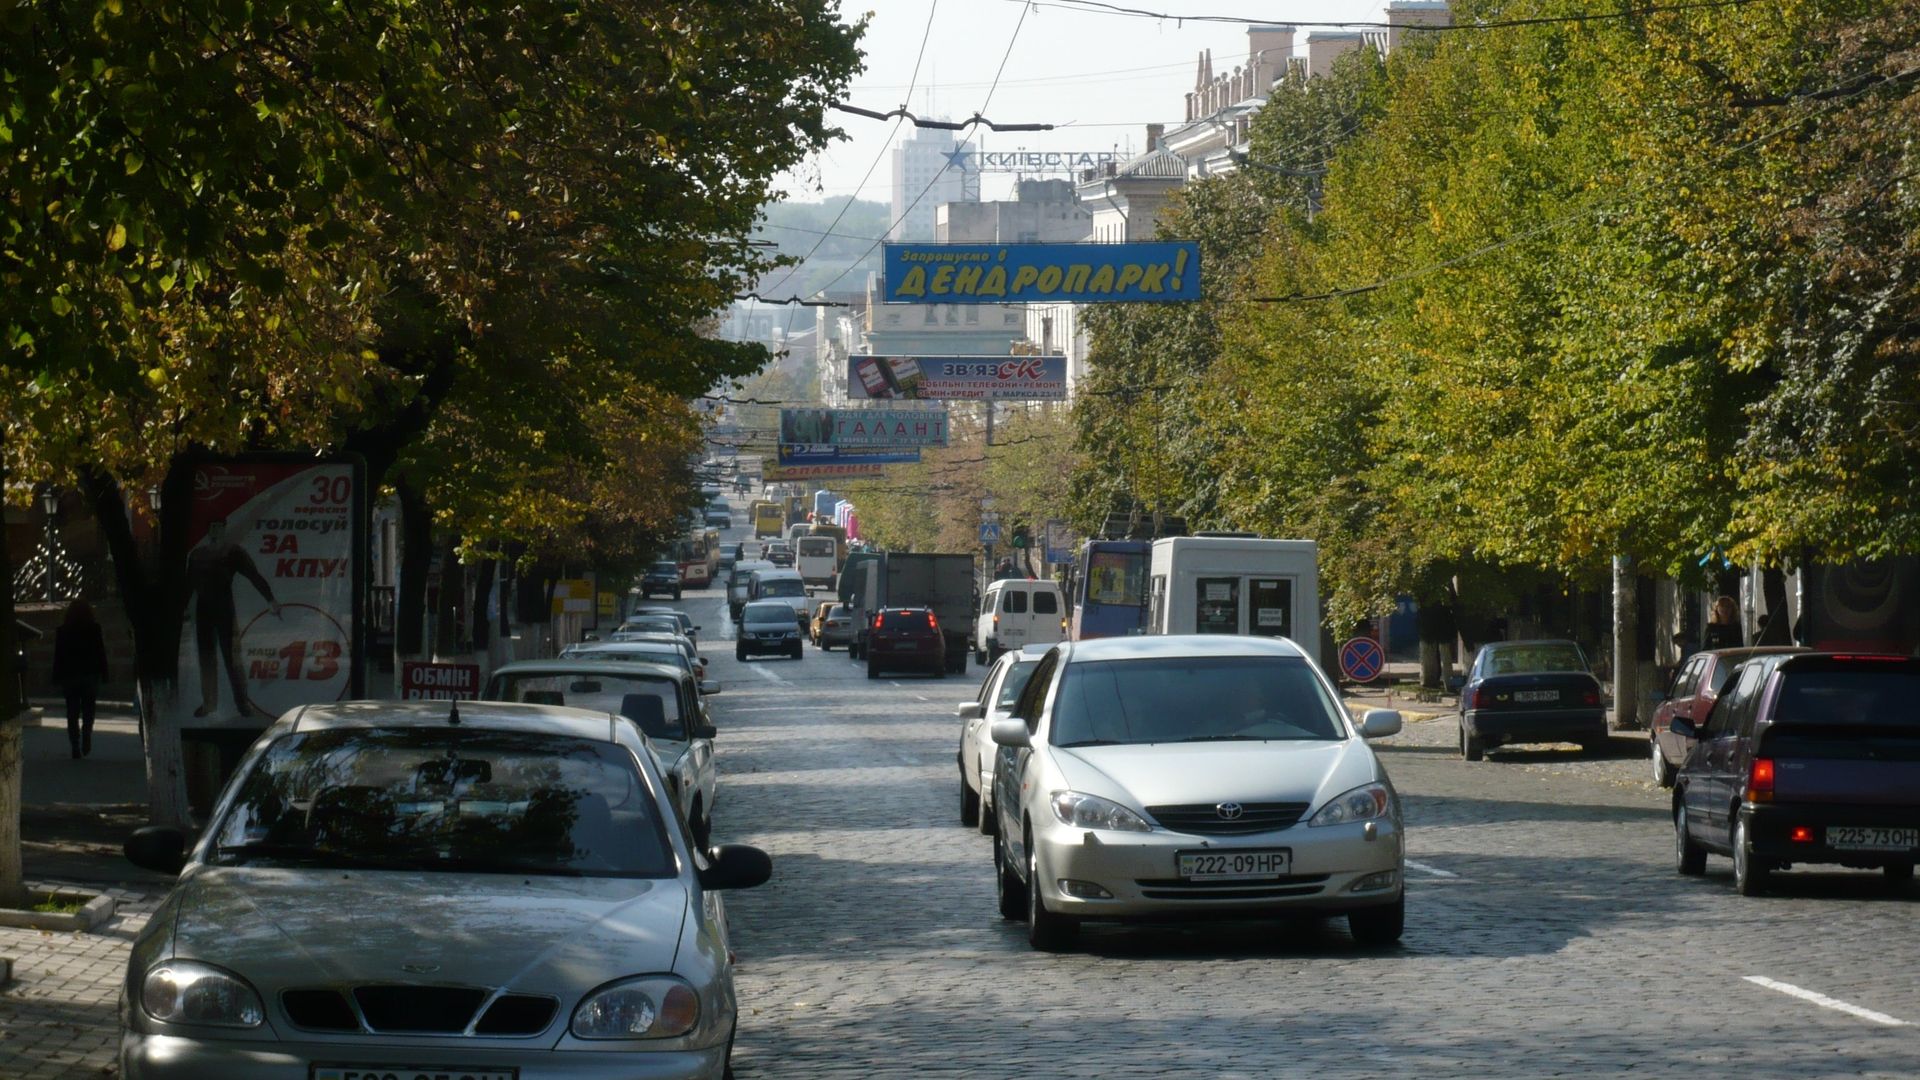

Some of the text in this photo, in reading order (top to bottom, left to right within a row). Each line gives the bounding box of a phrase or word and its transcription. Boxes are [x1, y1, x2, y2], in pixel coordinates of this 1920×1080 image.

[981, 147, 1112, 168] КИЇВСТАР
[901, 249, 1006, 263] Запрошуємо в
[896, 248, 1188, 298] ДЕНДРОПАРК!
[918, 381, 964, 389] МОБІЛЬНІ
[838, 421, 943, 435] ГАЛАНТ
[310, 475, 350, 505] 30
[256, 515, 348, 534] голосуй
[259, 534, 298, 554] ЗА
[275, 558, 348, 578] КПУ!
[411, 667, 471, 687] ОБМІН
